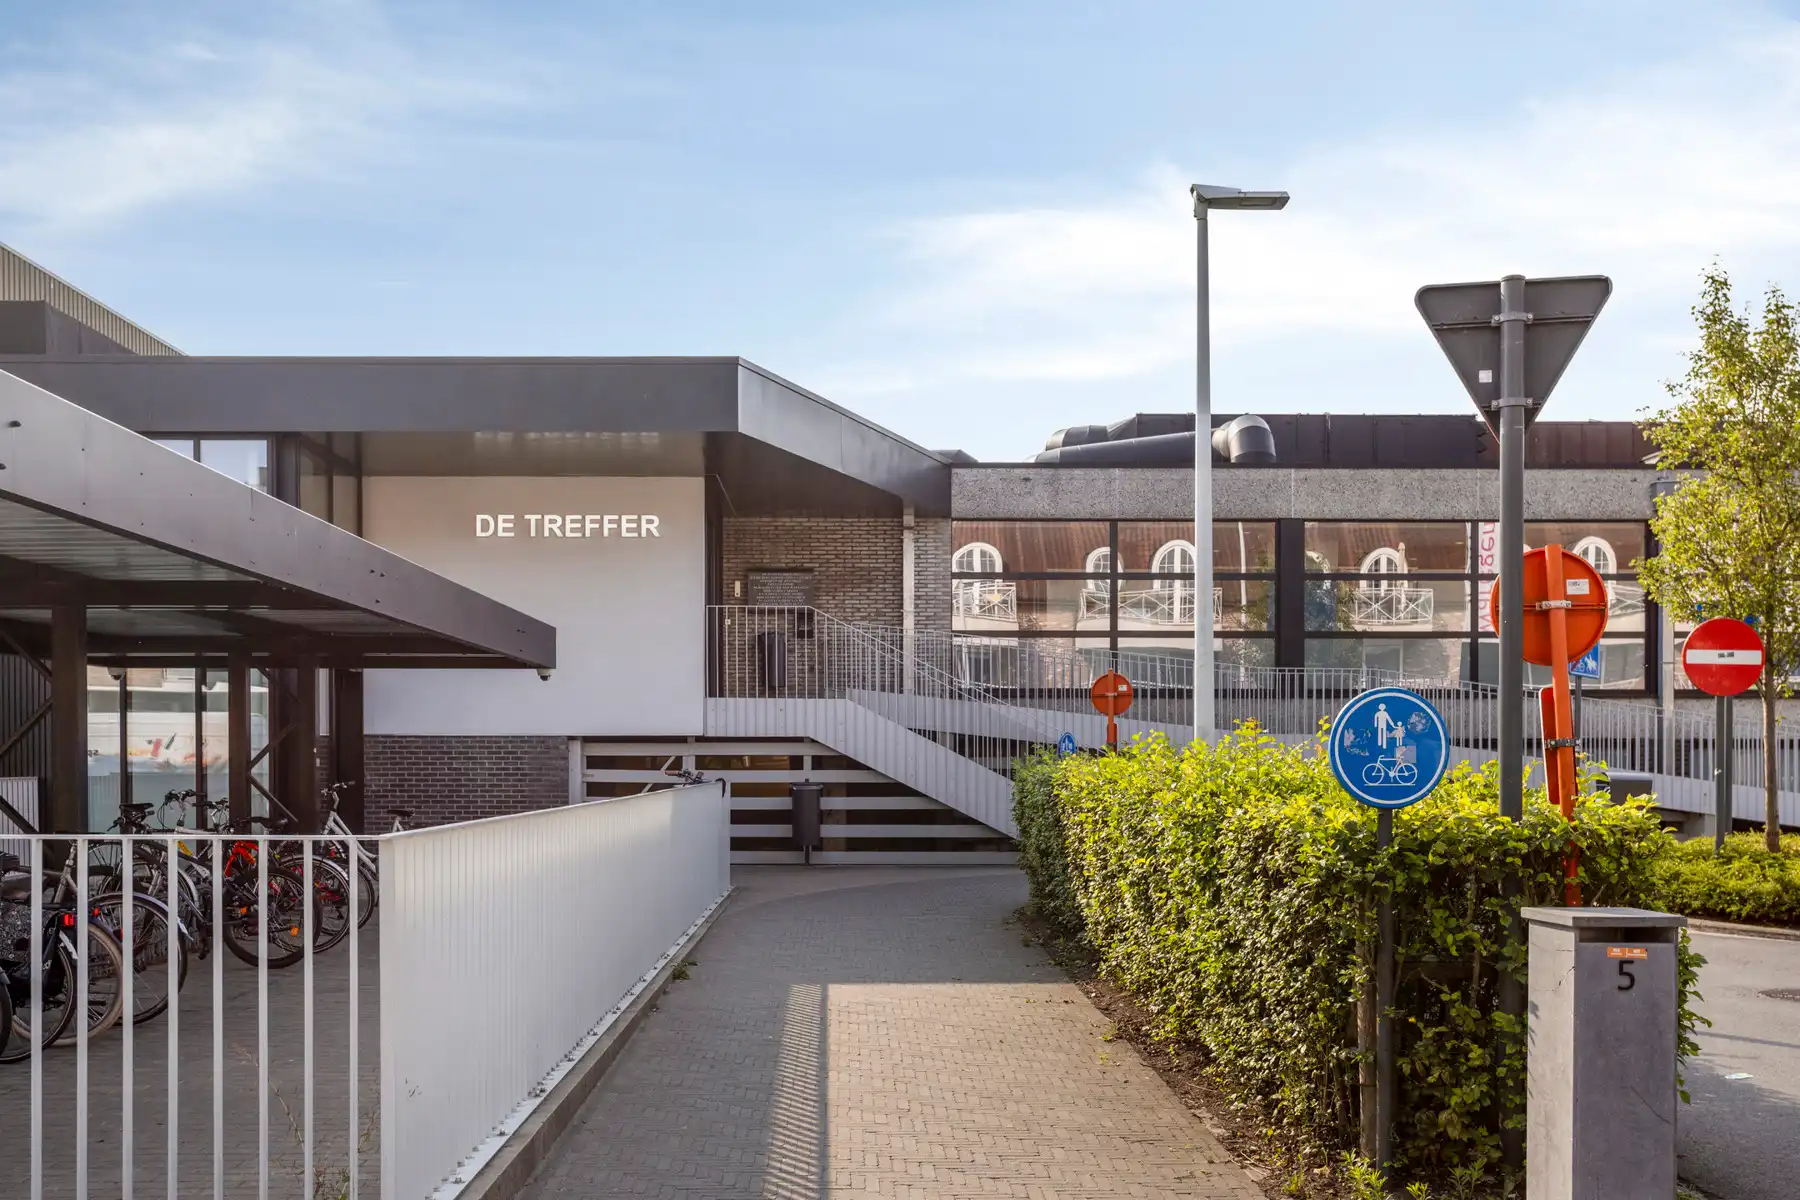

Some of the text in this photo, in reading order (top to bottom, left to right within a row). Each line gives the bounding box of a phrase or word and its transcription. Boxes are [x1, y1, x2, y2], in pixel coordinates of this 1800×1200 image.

[475, 514, 661, 538] DE TREFFER
[1617, 960, 1636, 991] 5
